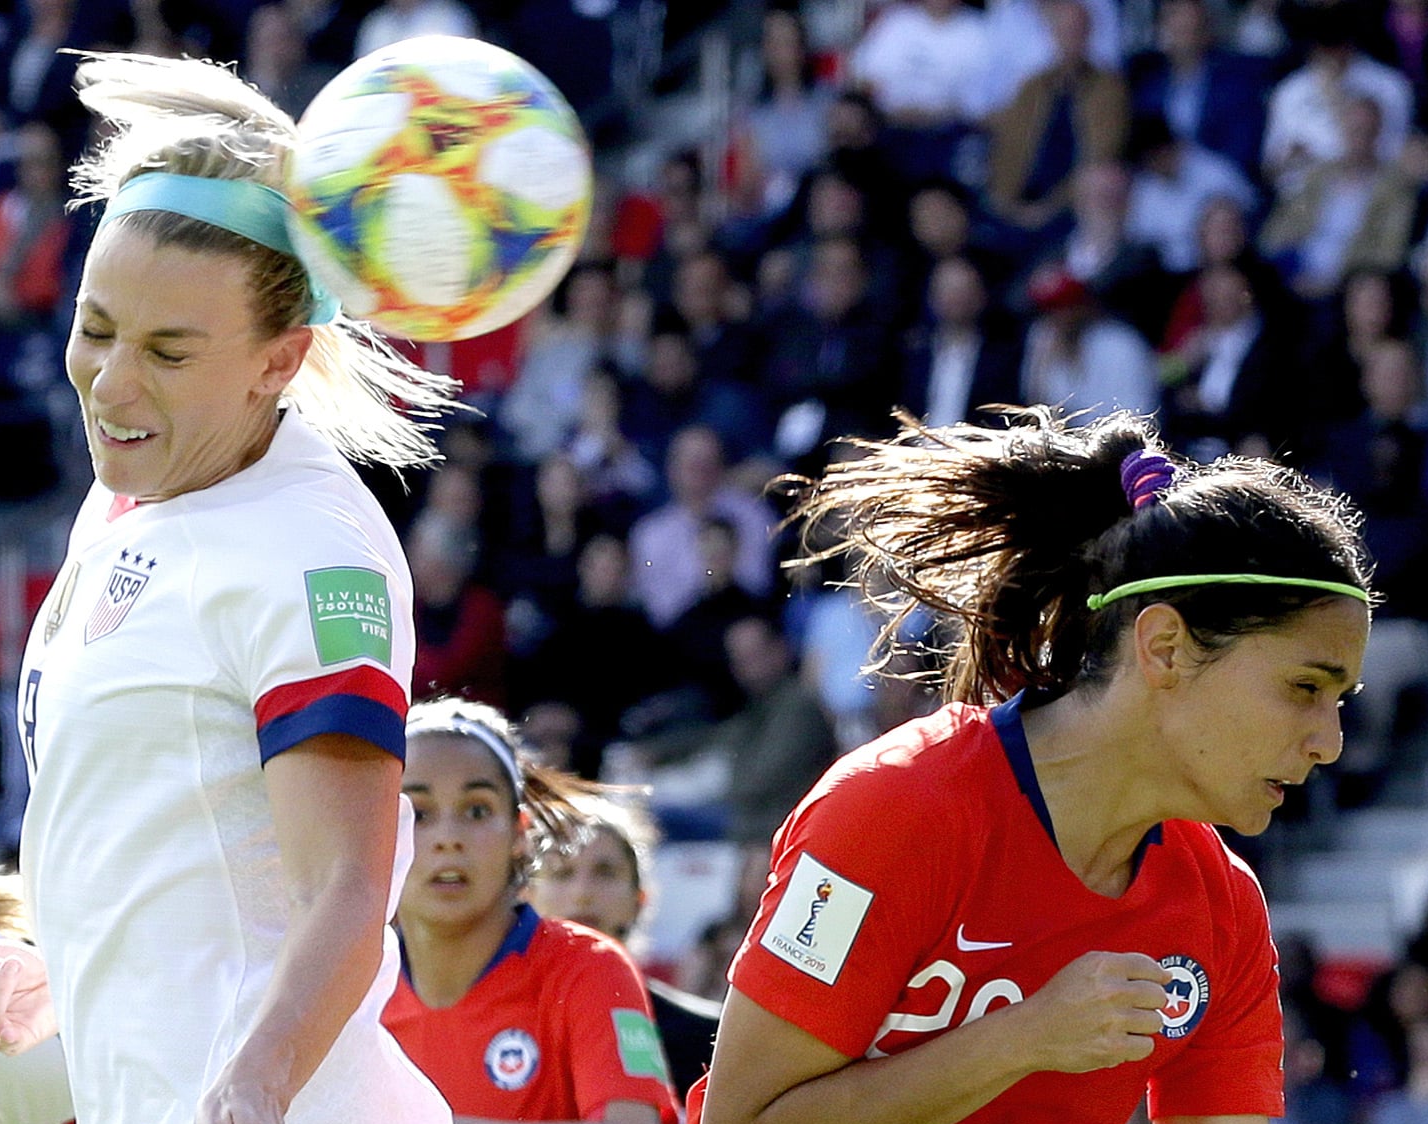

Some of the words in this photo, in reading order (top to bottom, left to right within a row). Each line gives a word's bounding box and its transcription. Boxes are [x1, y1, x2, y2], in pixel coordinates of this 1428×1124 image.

[109, 572, 142, 604] USA
[315, 591, 386, 607] LIVING
[316, 601, 386, 618] FOOTBALL
[361, 621, 388, 640] FIFA
[772, 935, 805, 962] FRANCE
[804, 956, 826, 972] 2019
